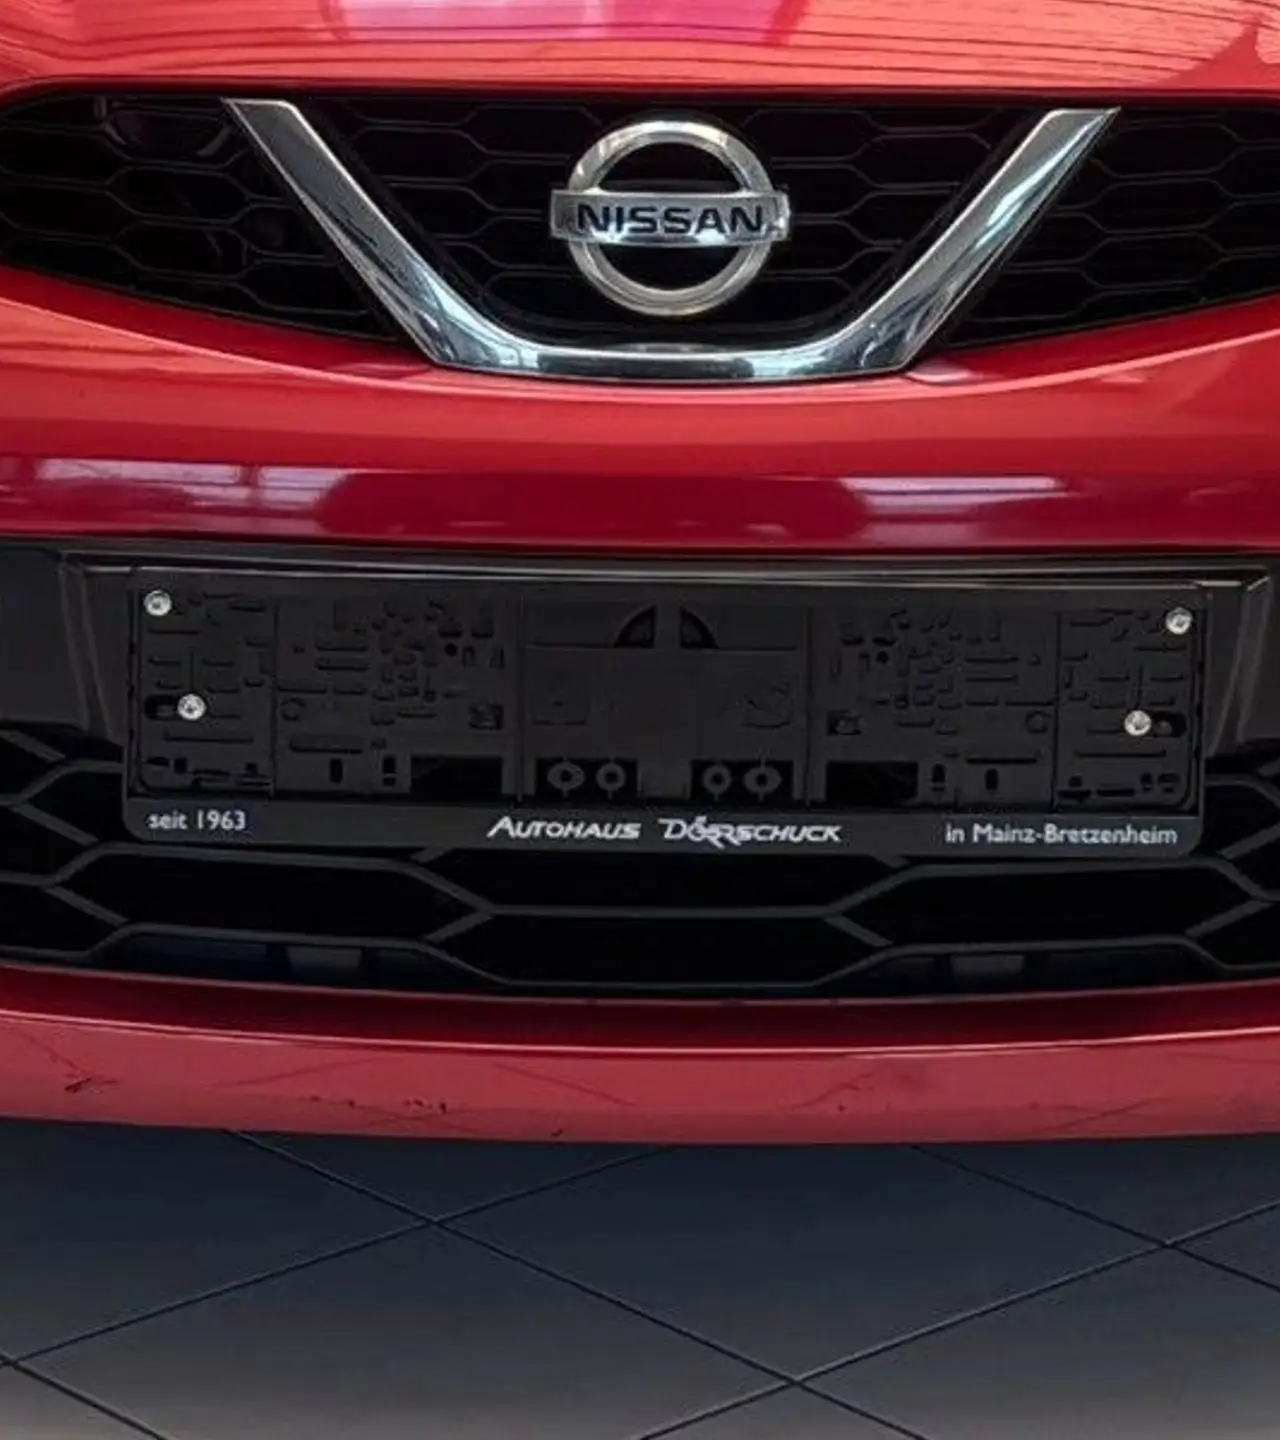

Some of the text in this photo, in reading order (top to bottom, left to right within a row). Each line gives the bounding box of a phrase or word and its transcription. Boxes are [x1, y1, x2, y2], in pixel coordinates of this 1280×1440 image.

[577, 204, 762, 234] NISSAN
[148, 809, 188, 829] seit
[197, 809, 246, 831] 1963
[945, 823, 966, 843] in
[973, 823, 1178, 844] Mainz-Bretzenheim
